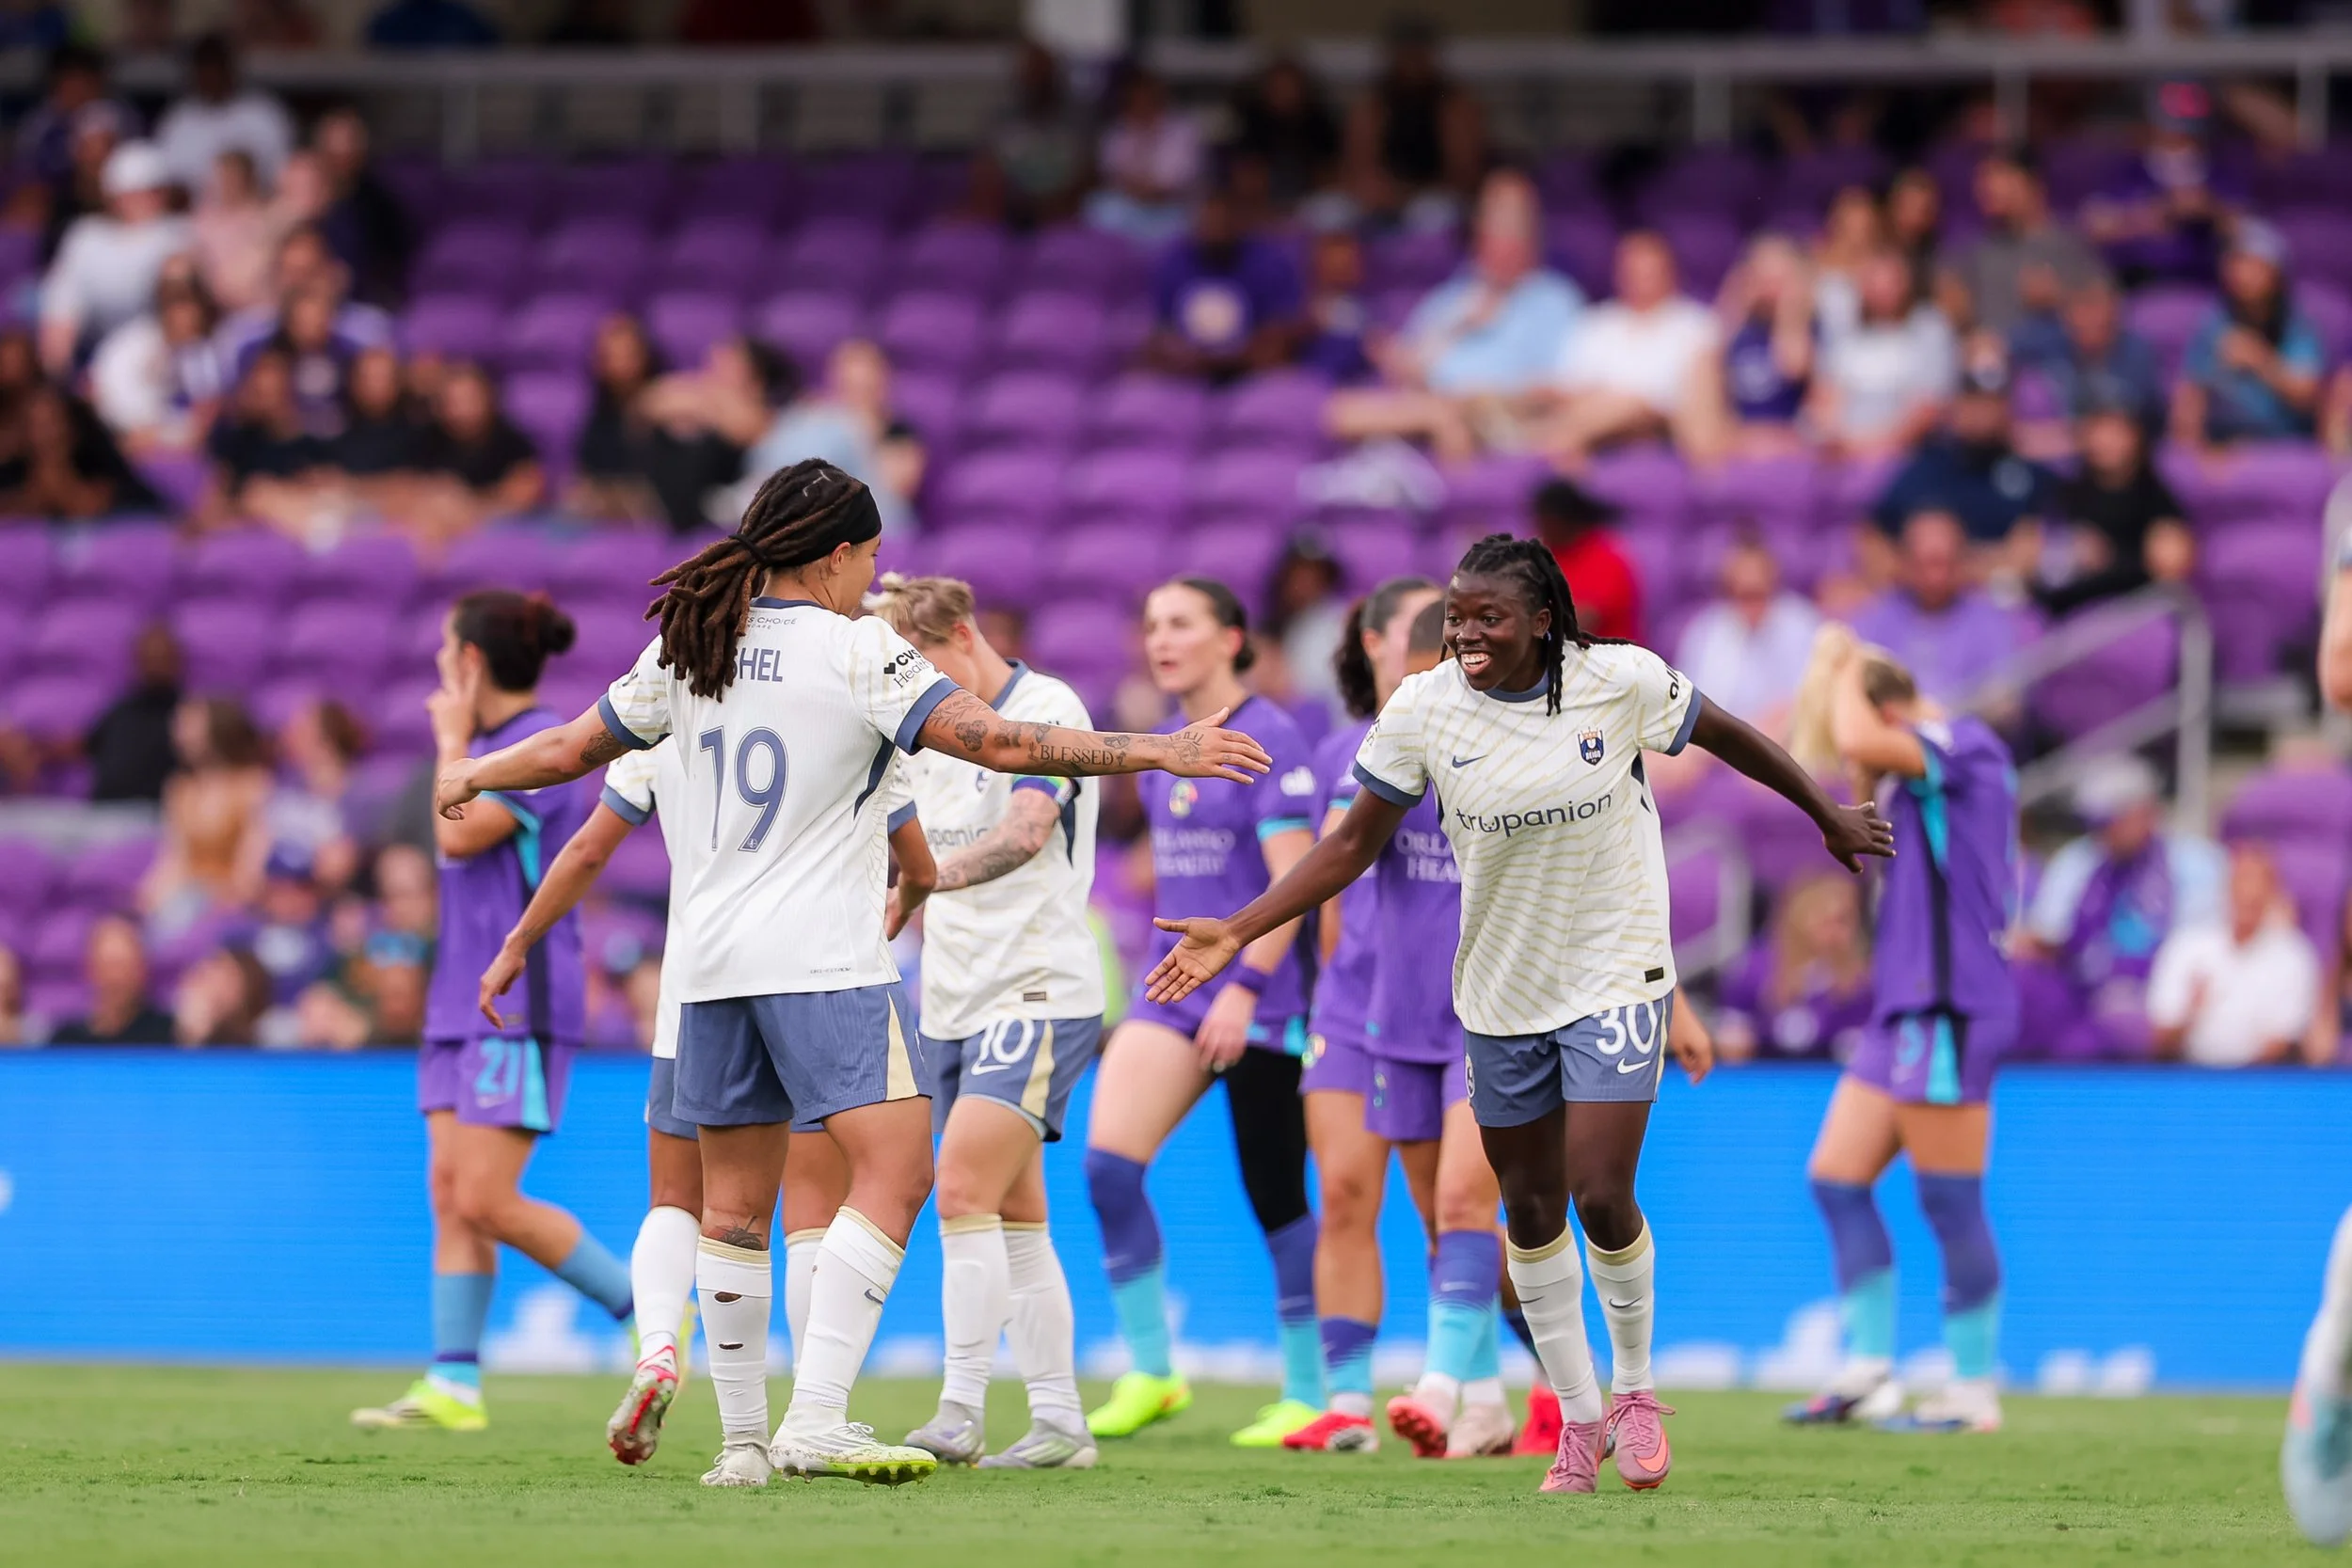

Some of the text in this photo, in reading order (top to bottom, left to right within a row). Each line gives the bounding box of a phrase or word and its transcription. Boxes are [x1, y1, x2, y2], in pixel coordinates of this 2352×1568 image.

[895, 649, 922, 667] CVS
[1040, 744, 1115, 766] BLESSED
[698, 724, 789, 853] 19
[1455, 793, 1613, 838] trupanion
[979, 1019, 1035, 1065] 10
[1595, 1002, 1659, 1055] 30
